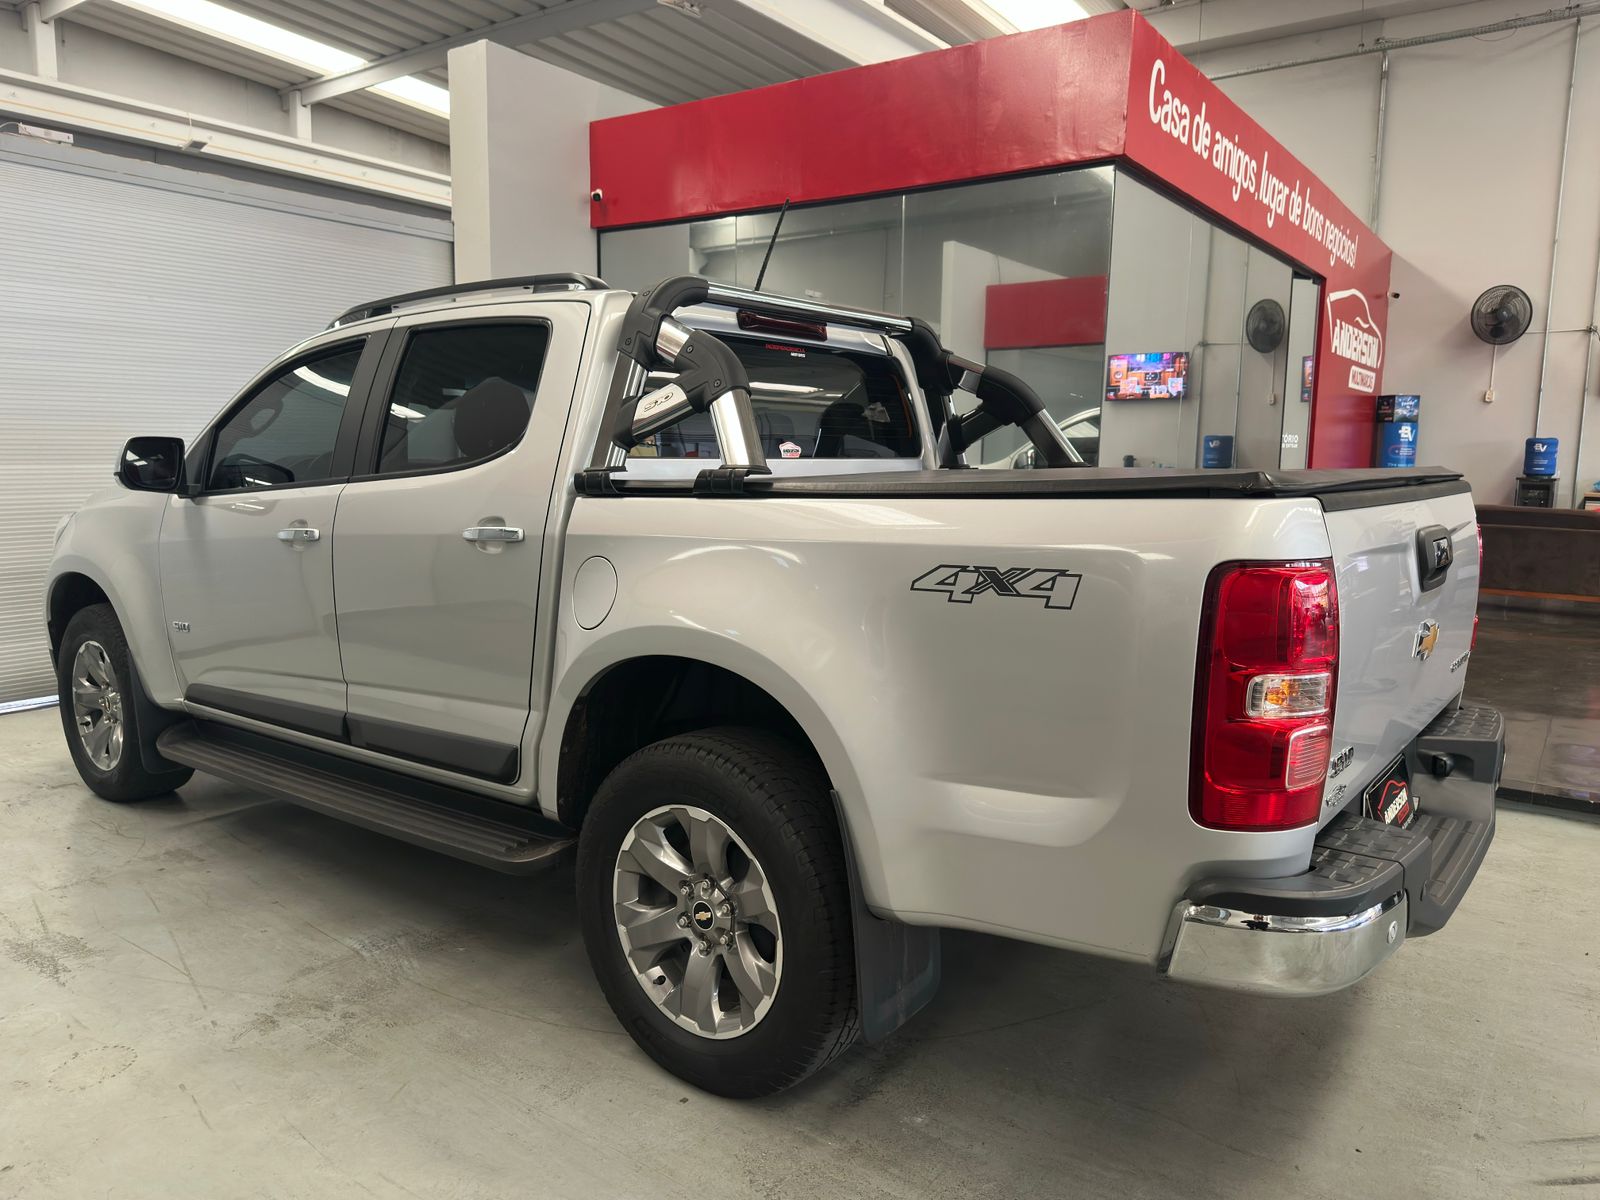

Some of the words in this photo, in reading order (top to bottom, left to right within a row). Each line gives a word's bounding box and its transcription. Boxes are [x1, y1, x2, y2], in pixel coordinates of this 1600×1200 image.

[1149, 58, 1190, 145] Casa
[1192, 101, 1211, 160] de
[1212, 130, 1258, 202] amigos,
[1259, 150, 1290, 229] lugar
[1288, 179, 1302, 226] de
[1302, 186, 1324, 242] bons
[1322, 218, 1359, 269] negócios!
[1331, 318, 1379, 368] ANDERSON
